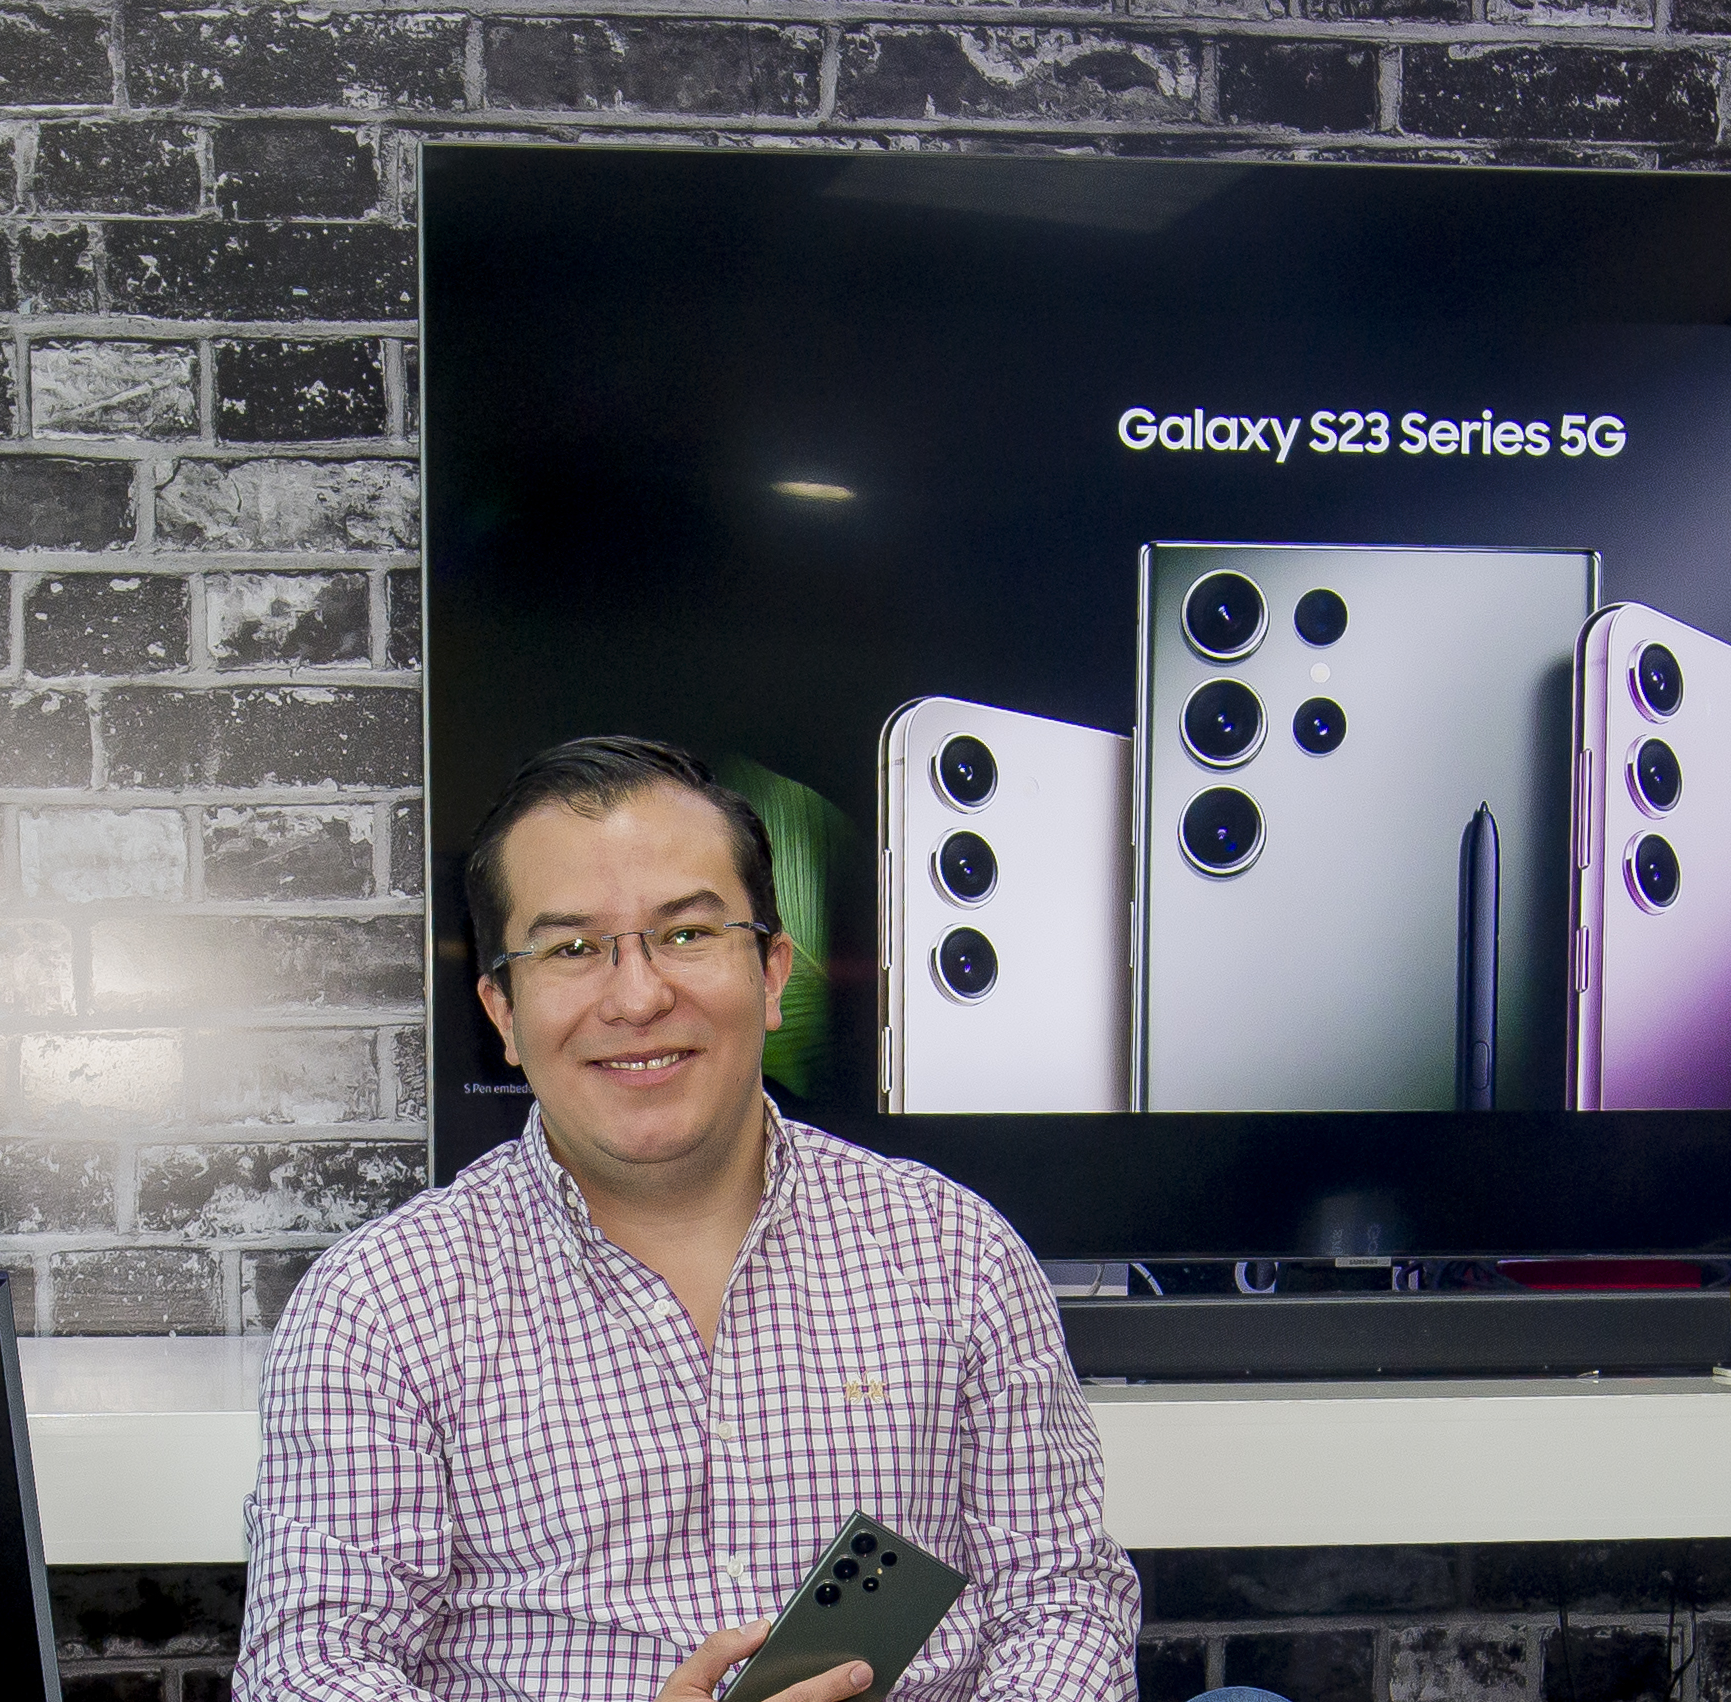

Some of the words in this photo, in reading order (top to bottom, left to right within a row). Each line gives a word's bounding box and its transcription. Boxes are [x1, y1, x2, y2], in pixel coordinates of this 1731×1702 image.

[1118, 407, 1300, 463] Galaxy
[1309, 410, 1391, 455] S23
[1399, 409, 1550, 456] Series
[1560, 413, 1627, 457] 5G
[463, 1083, 471, 1094] S
[472, 1083, 492, 1094] Pen
